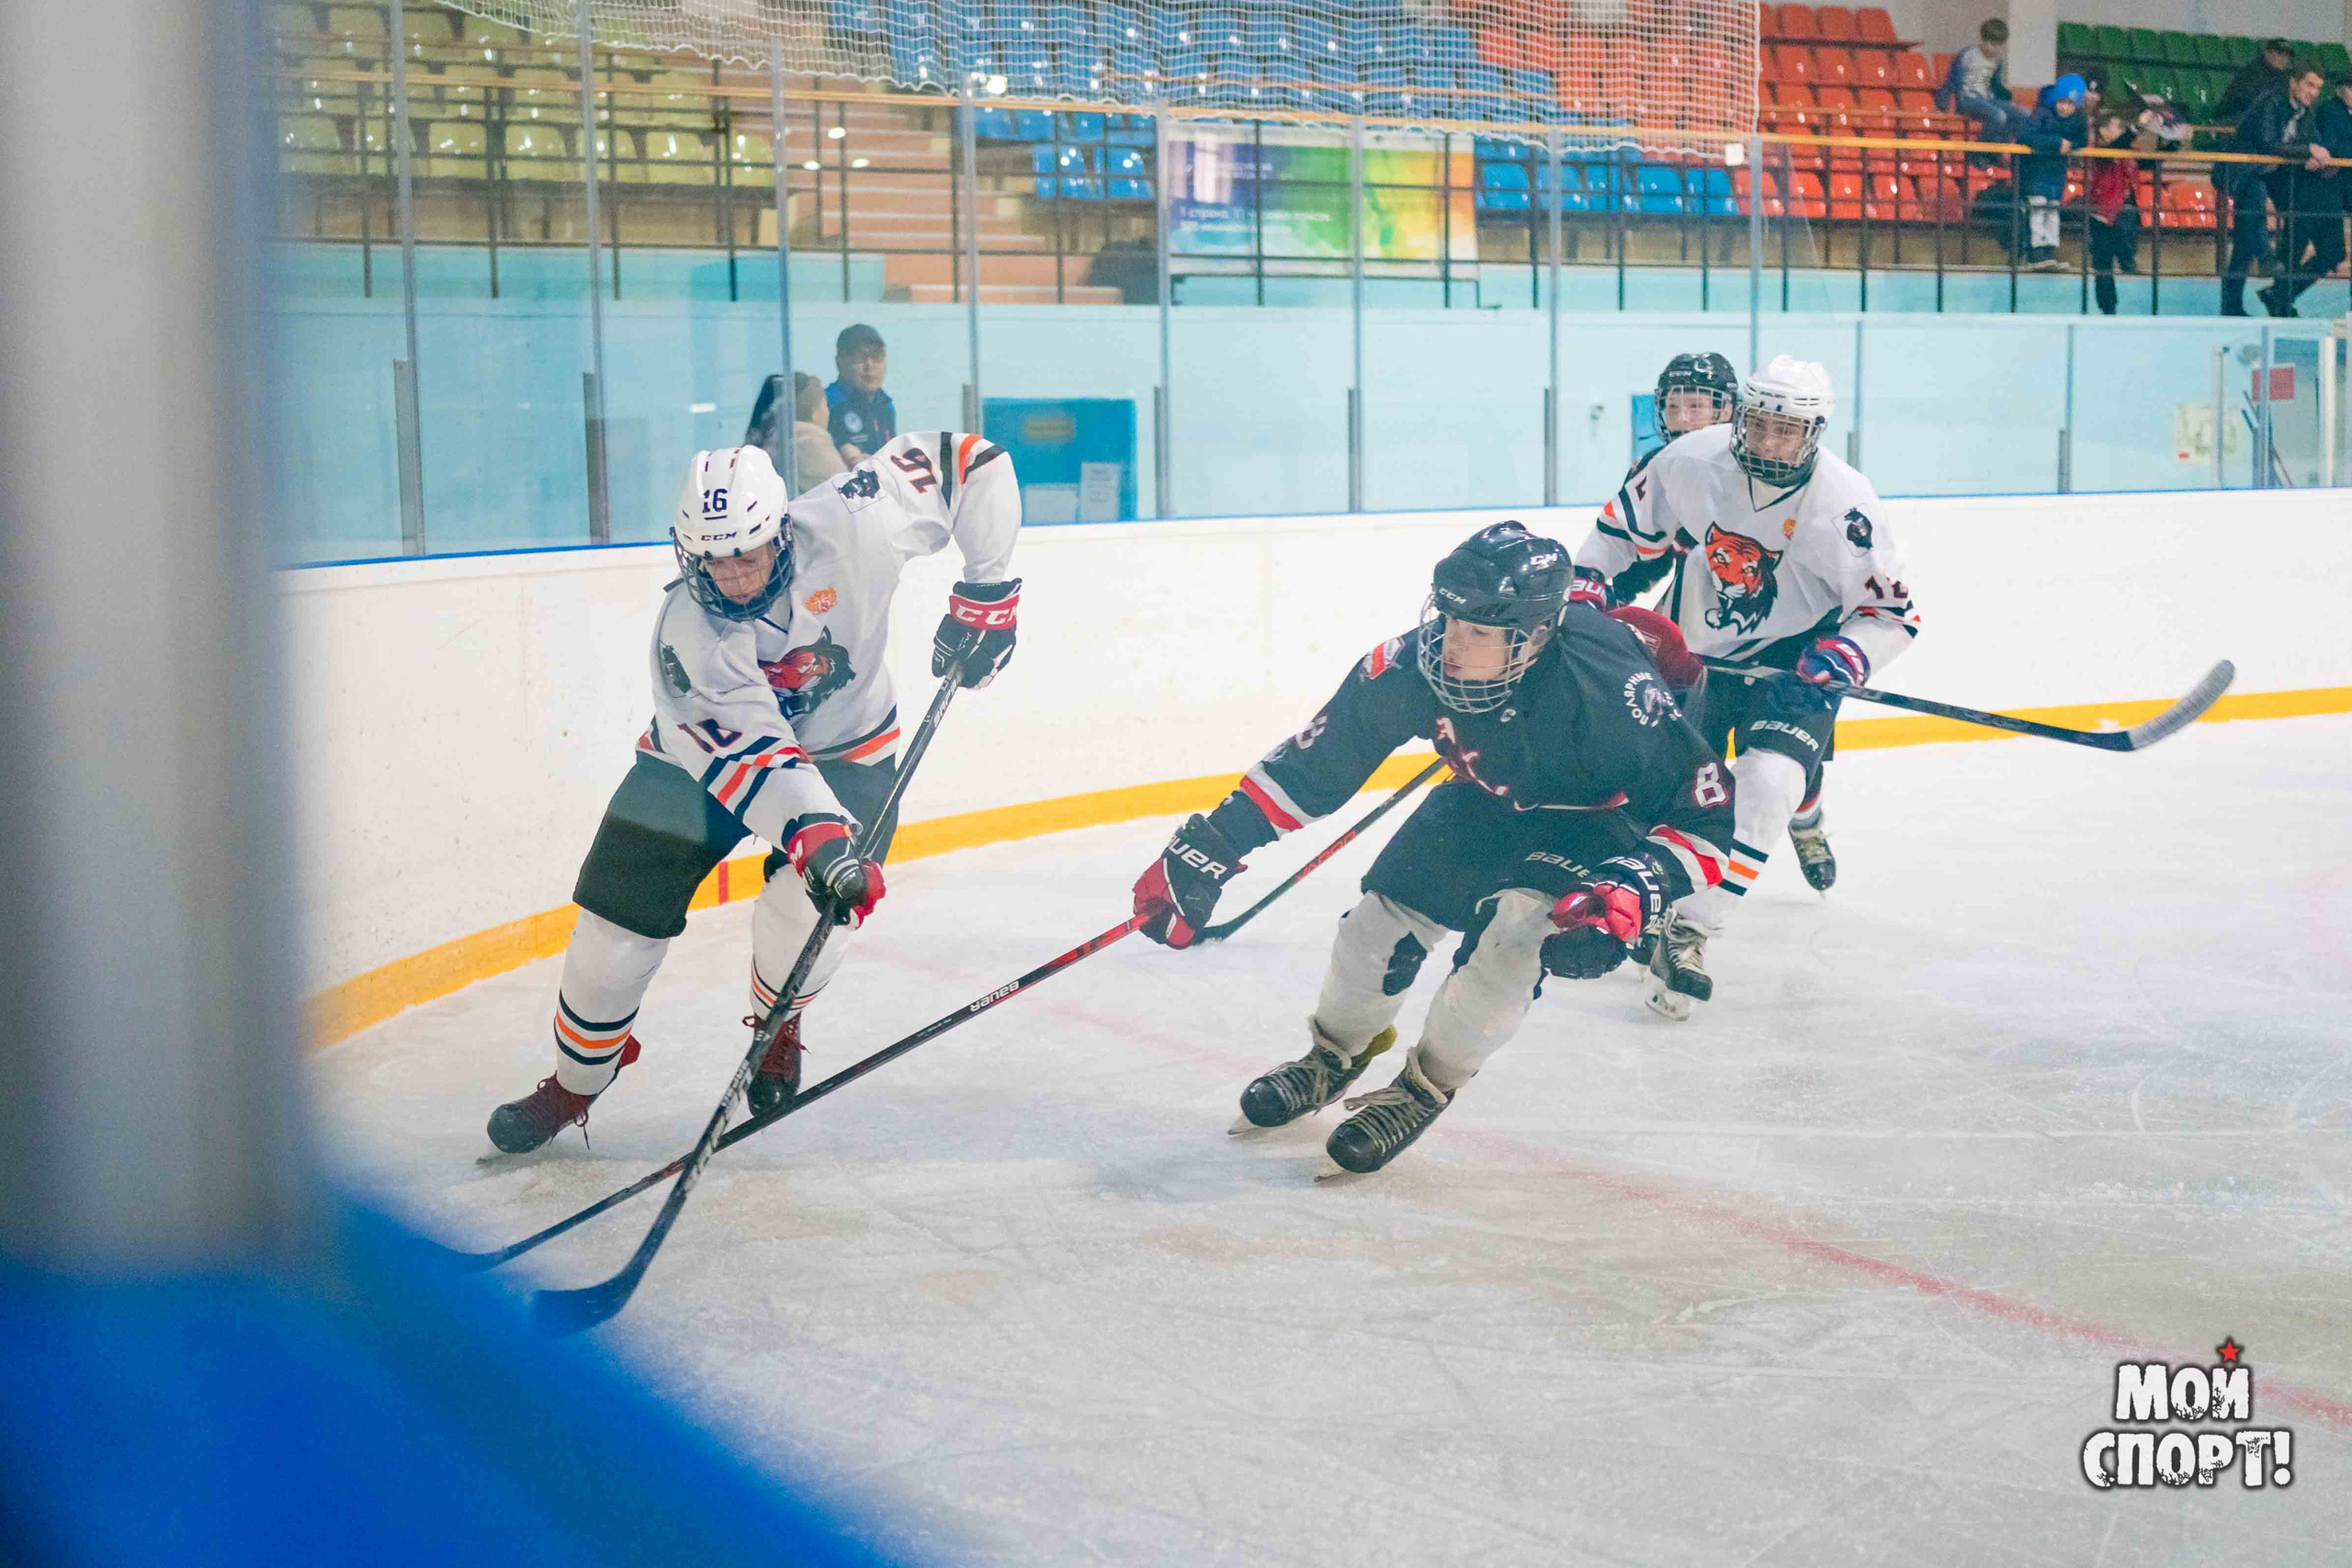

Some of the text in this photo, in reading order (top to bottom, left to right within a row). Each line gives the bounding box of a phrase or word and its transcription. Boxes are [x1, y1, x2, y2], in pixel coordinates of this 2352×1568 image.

[702, 488, 728, 513] 16
[701, 531, 737, 541] CCM
[1439, 587, 1467, 604] CCM
[1694, 761, 1731, 808] 8
[1168, 835, 1228, 881] UER
[1524, 851, 1590, 878] BAUE
